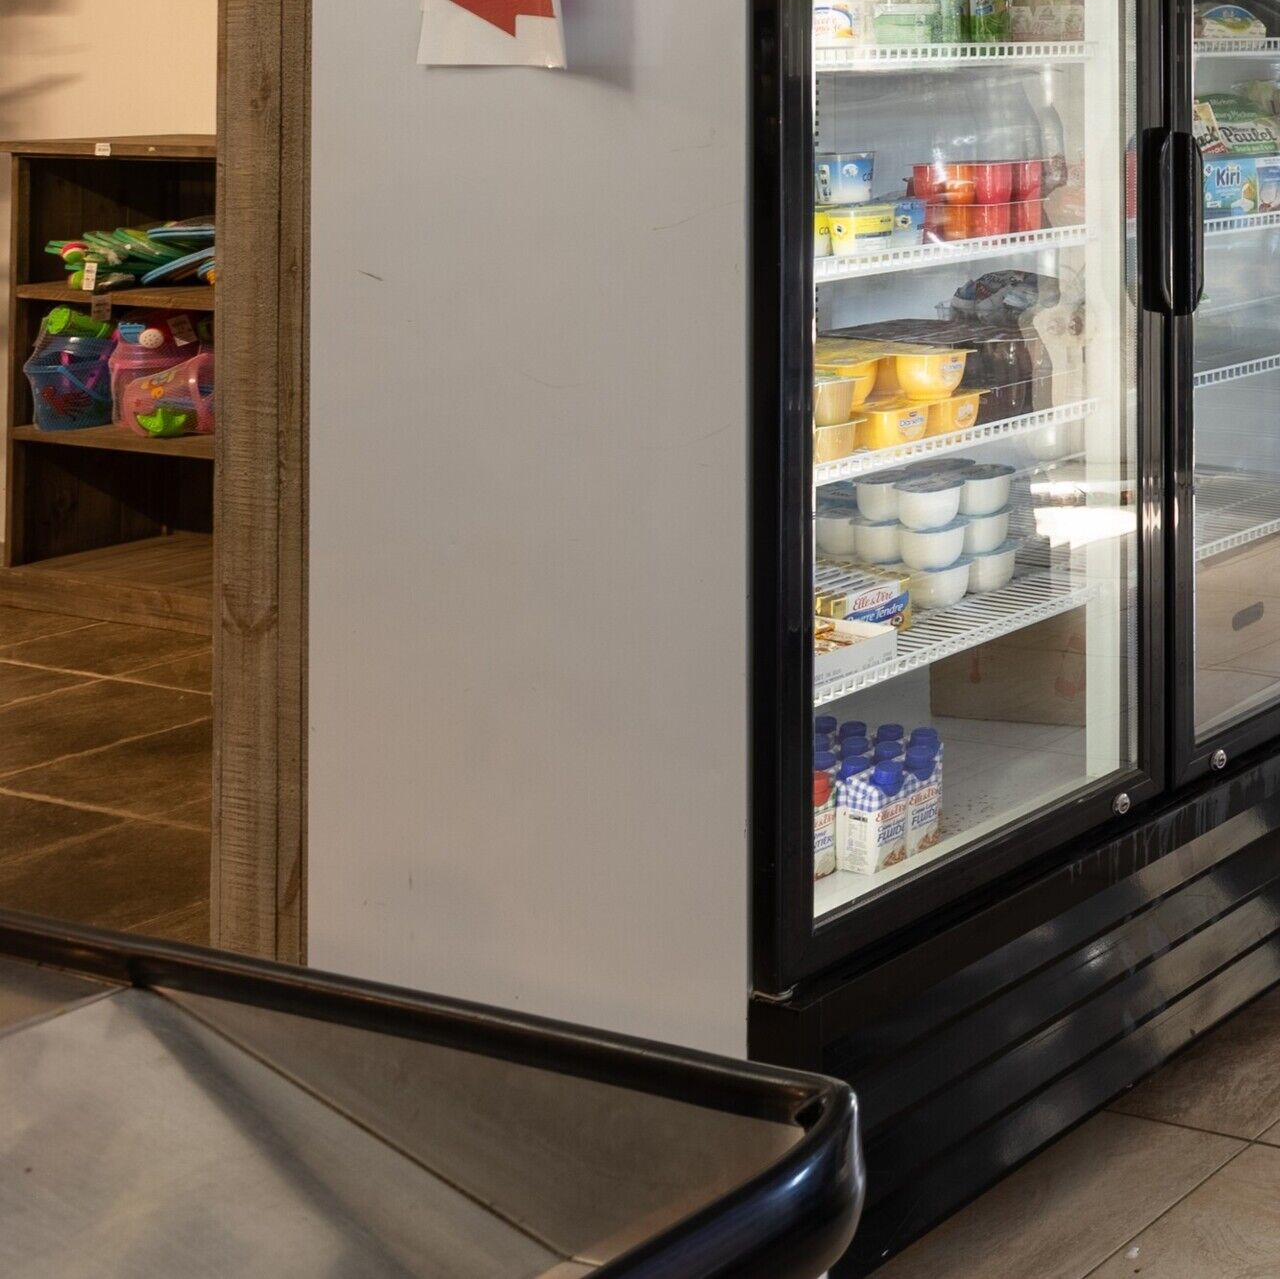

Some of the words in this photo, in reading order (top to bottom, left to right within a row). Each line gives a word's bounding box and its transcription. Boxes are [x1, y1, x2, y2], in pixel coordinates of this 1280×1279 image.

[1218, 125, 1278, 144] Poulet
[1215, 166, 1242, 187] Kiri
[874, 602, 904, 619] Tendre
